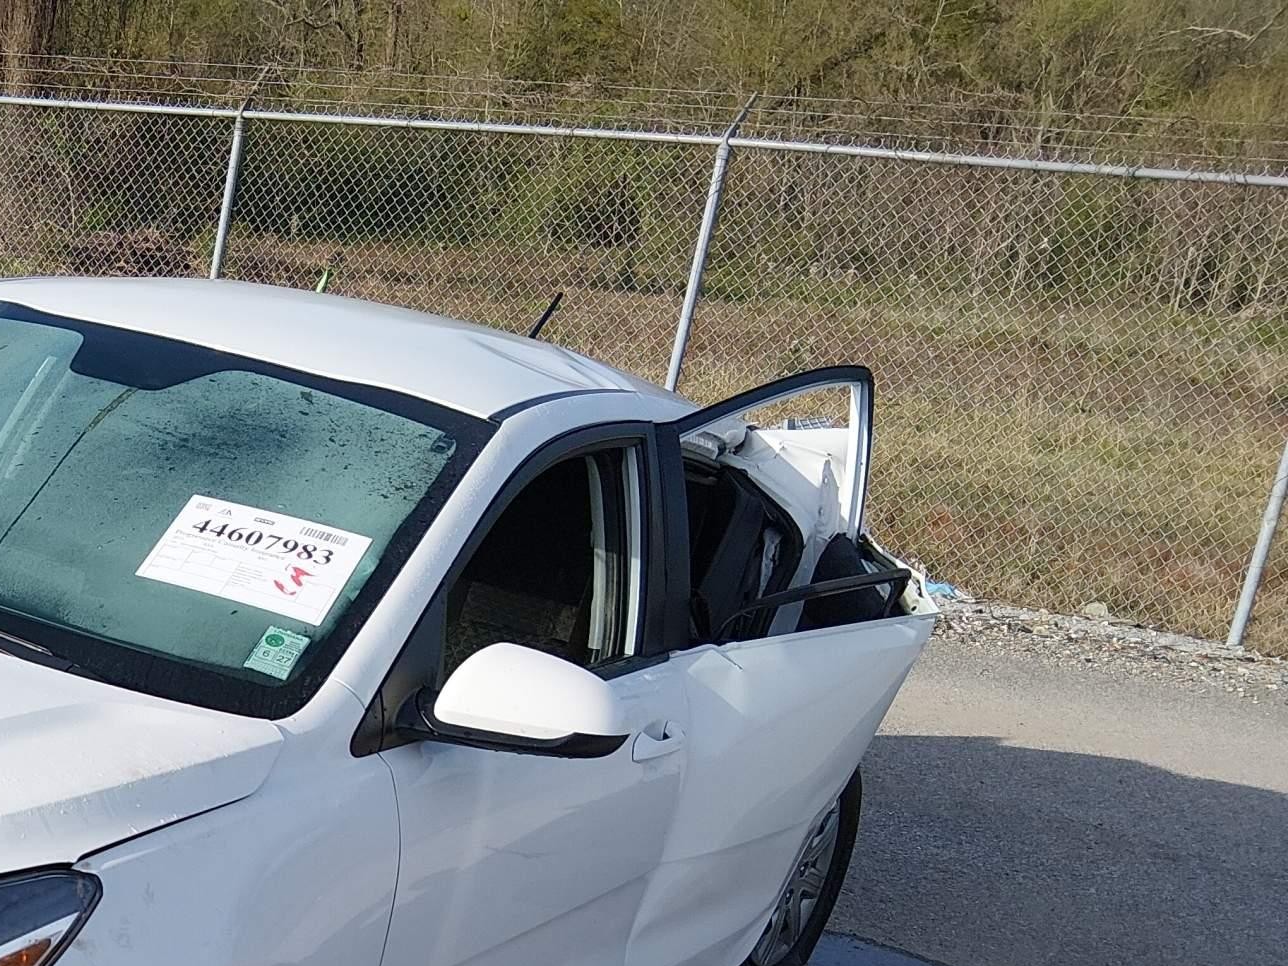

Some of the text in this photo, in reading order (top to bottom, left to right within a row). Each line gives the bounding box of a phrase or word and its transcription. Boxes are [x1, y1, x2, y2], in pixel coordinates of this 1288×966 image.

[192, 519, 334, 565] 44607983
[262, 649, 271, 658] 6
[277, 655, 292, 664] 27
